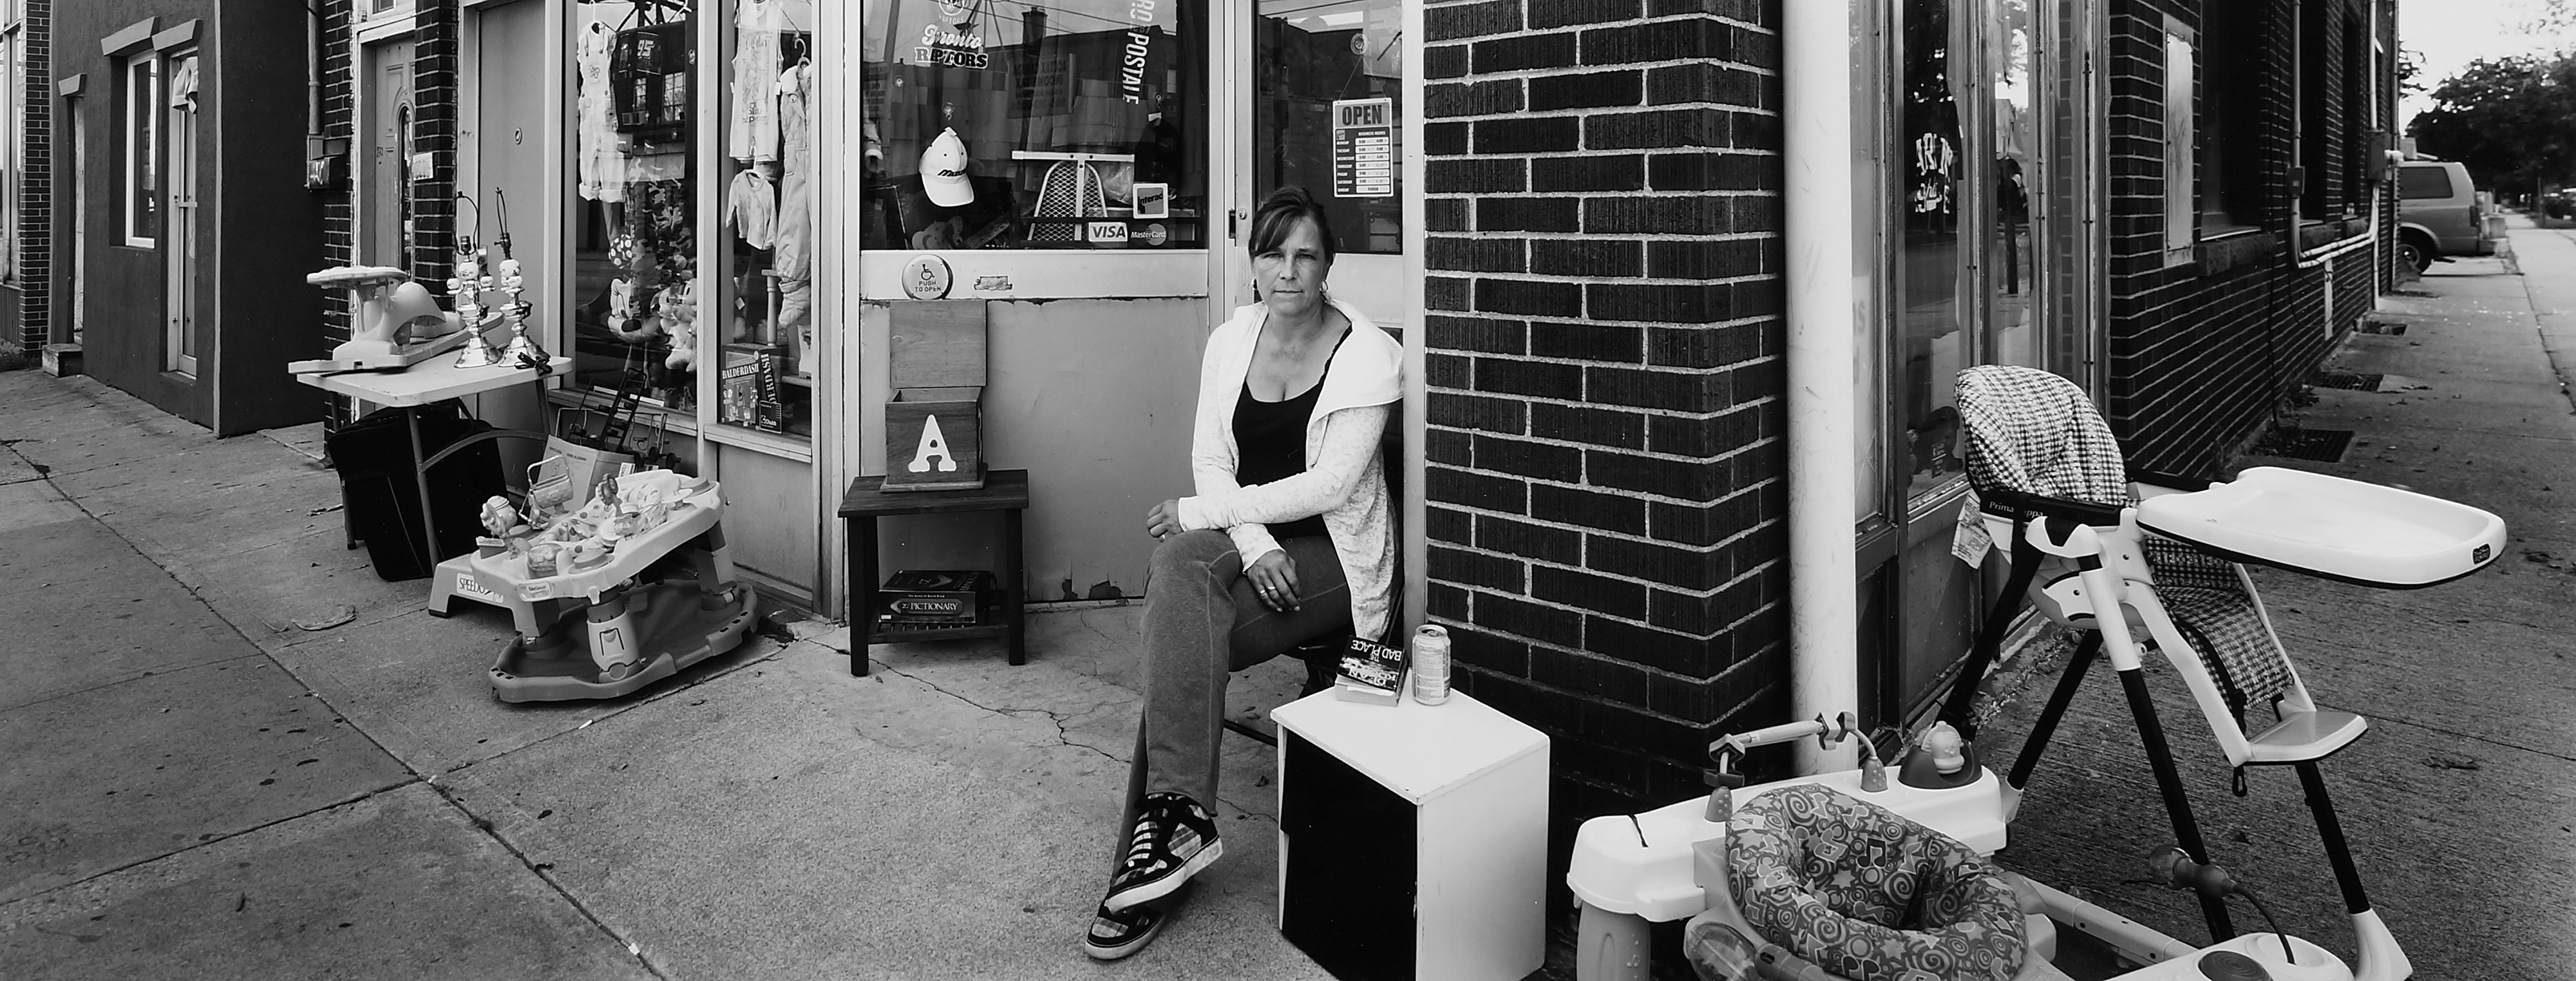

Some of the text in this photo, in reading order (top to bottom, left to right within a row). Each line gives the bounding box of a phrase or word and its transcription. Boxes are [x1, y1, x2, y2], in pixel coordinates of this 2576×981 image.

[637, 39, 656, 60] 95
[1122, 32, 1150, 104] POSTALE
[1342, 104, 1382, 126] OPEN
[1137, 193, 1163, 211] Interac
[1092, 225, 1126, 238] VISA
[722, 363, 759, 379] BALDERDASH
[907, 414, 957, 473] A
[1989, 501, 2015, 513] Prima
[911, 602, 959, 611] PICTIONARY
[1350, 640, 1402, 662] BAD PLACE
